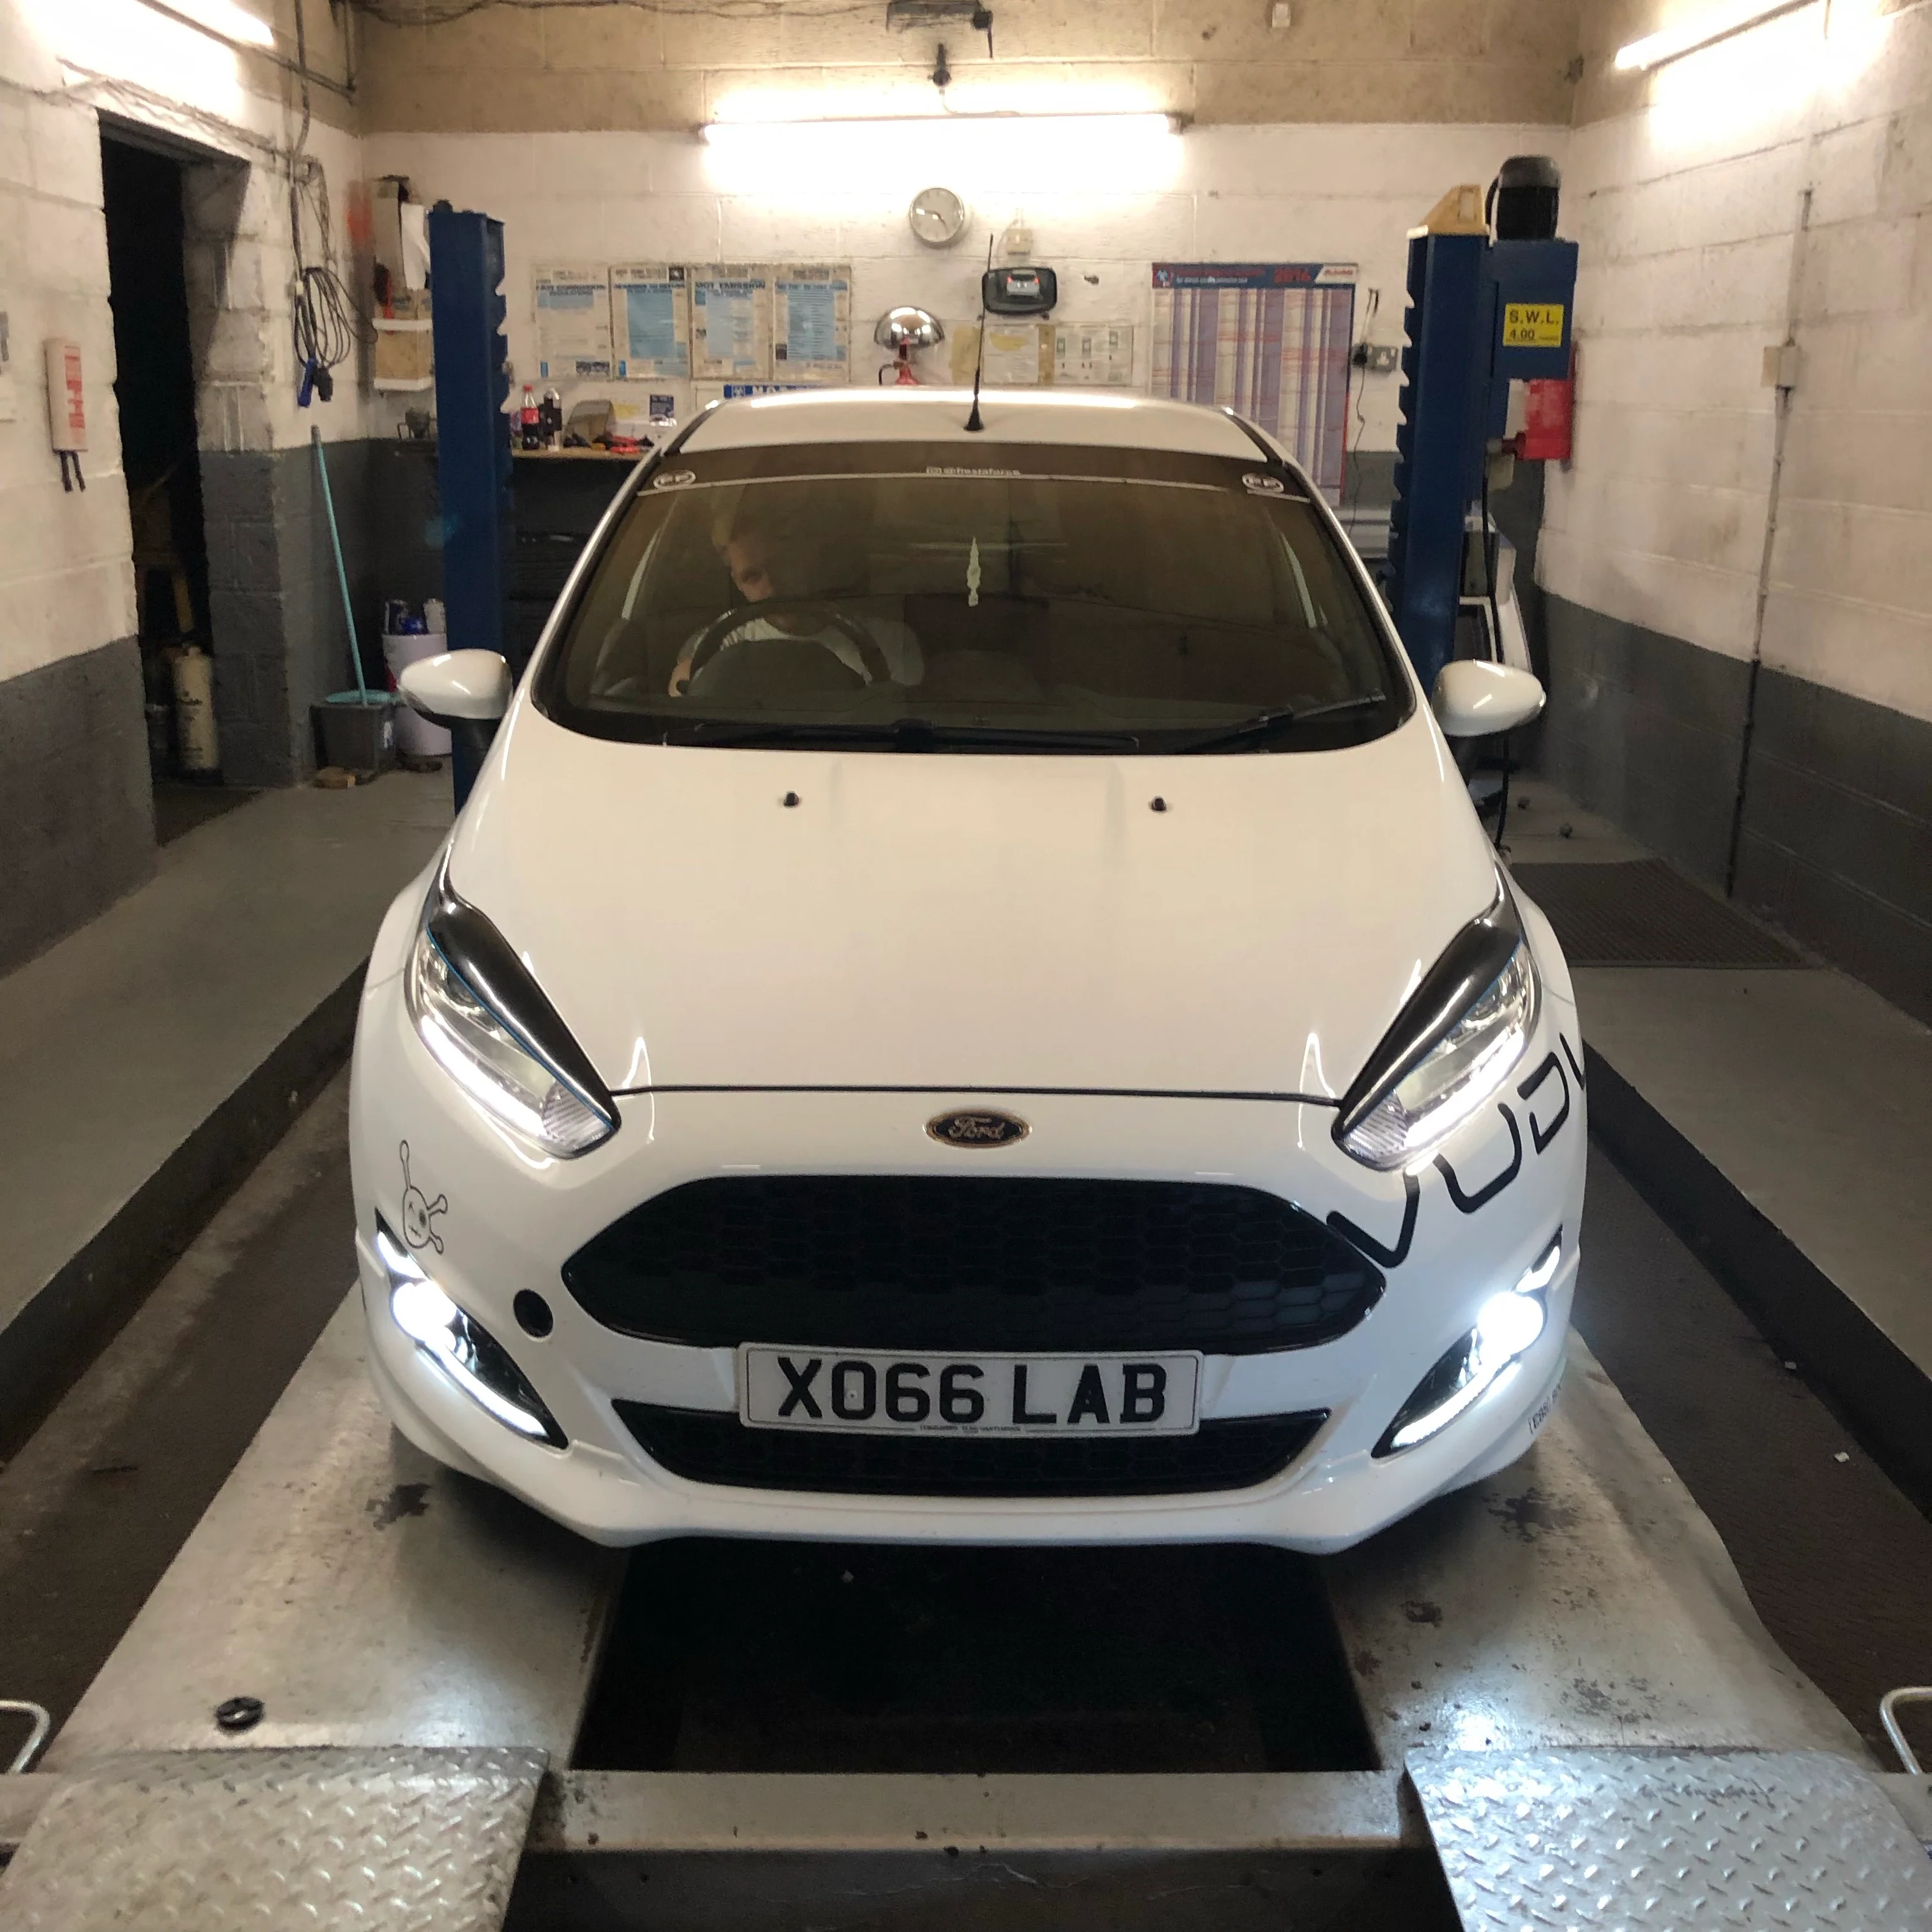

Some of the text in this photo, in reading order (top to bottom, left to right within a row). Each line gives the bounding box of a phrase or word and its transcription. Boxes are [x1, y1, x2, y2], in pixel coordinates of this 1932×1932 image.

[947, 1117, 1006, 1139] Ford
[778, 1356, 1167, 1425] XO66 LAB
